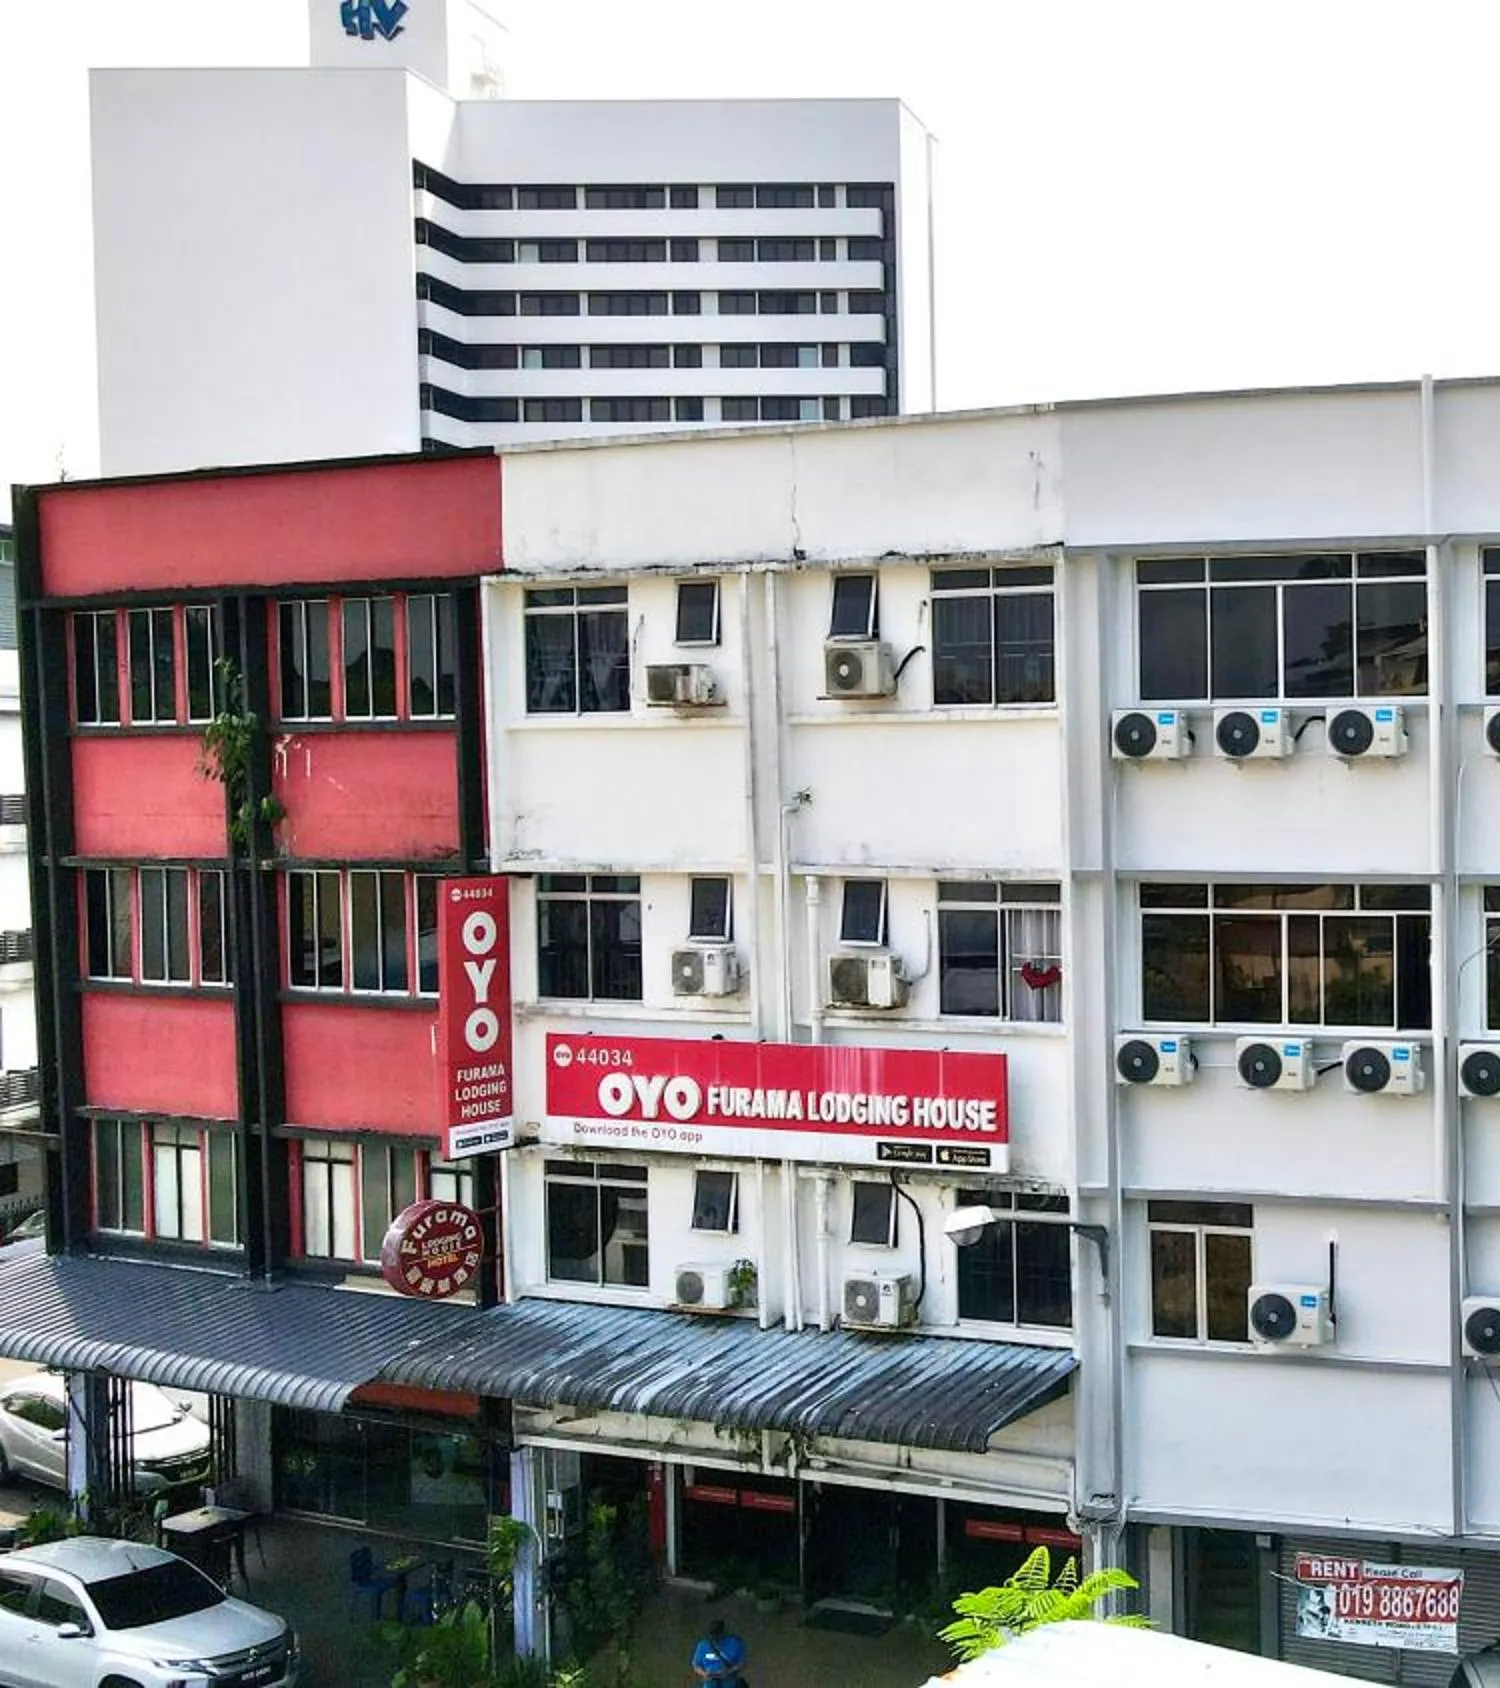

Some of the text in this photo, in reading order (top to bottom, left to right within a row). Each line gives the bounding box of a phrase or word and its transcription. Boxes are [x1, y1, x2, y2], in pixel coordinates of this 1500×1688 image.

[462, 911, 499, 1053] OYO
[576, 1049, 633, 1066] 44034
[457, 1063, 505, 1083] FURAMA
[455, 1081, 507, 1101] LODGING
[462, 1099, 501, 1118] HOUSE
[598, 1072, 998, 1132] OYO FURAMA LODGING HOUSE
[574, 1122, 703, 1143] Download the OYO app
[400, 1209, 477, 1255] Furama
[1311, 1561, 1359, 1578] RENT
[1401, 1567, 1423, 1579] Call
[1340, 1584, 1460, 1618] 019 8867688
